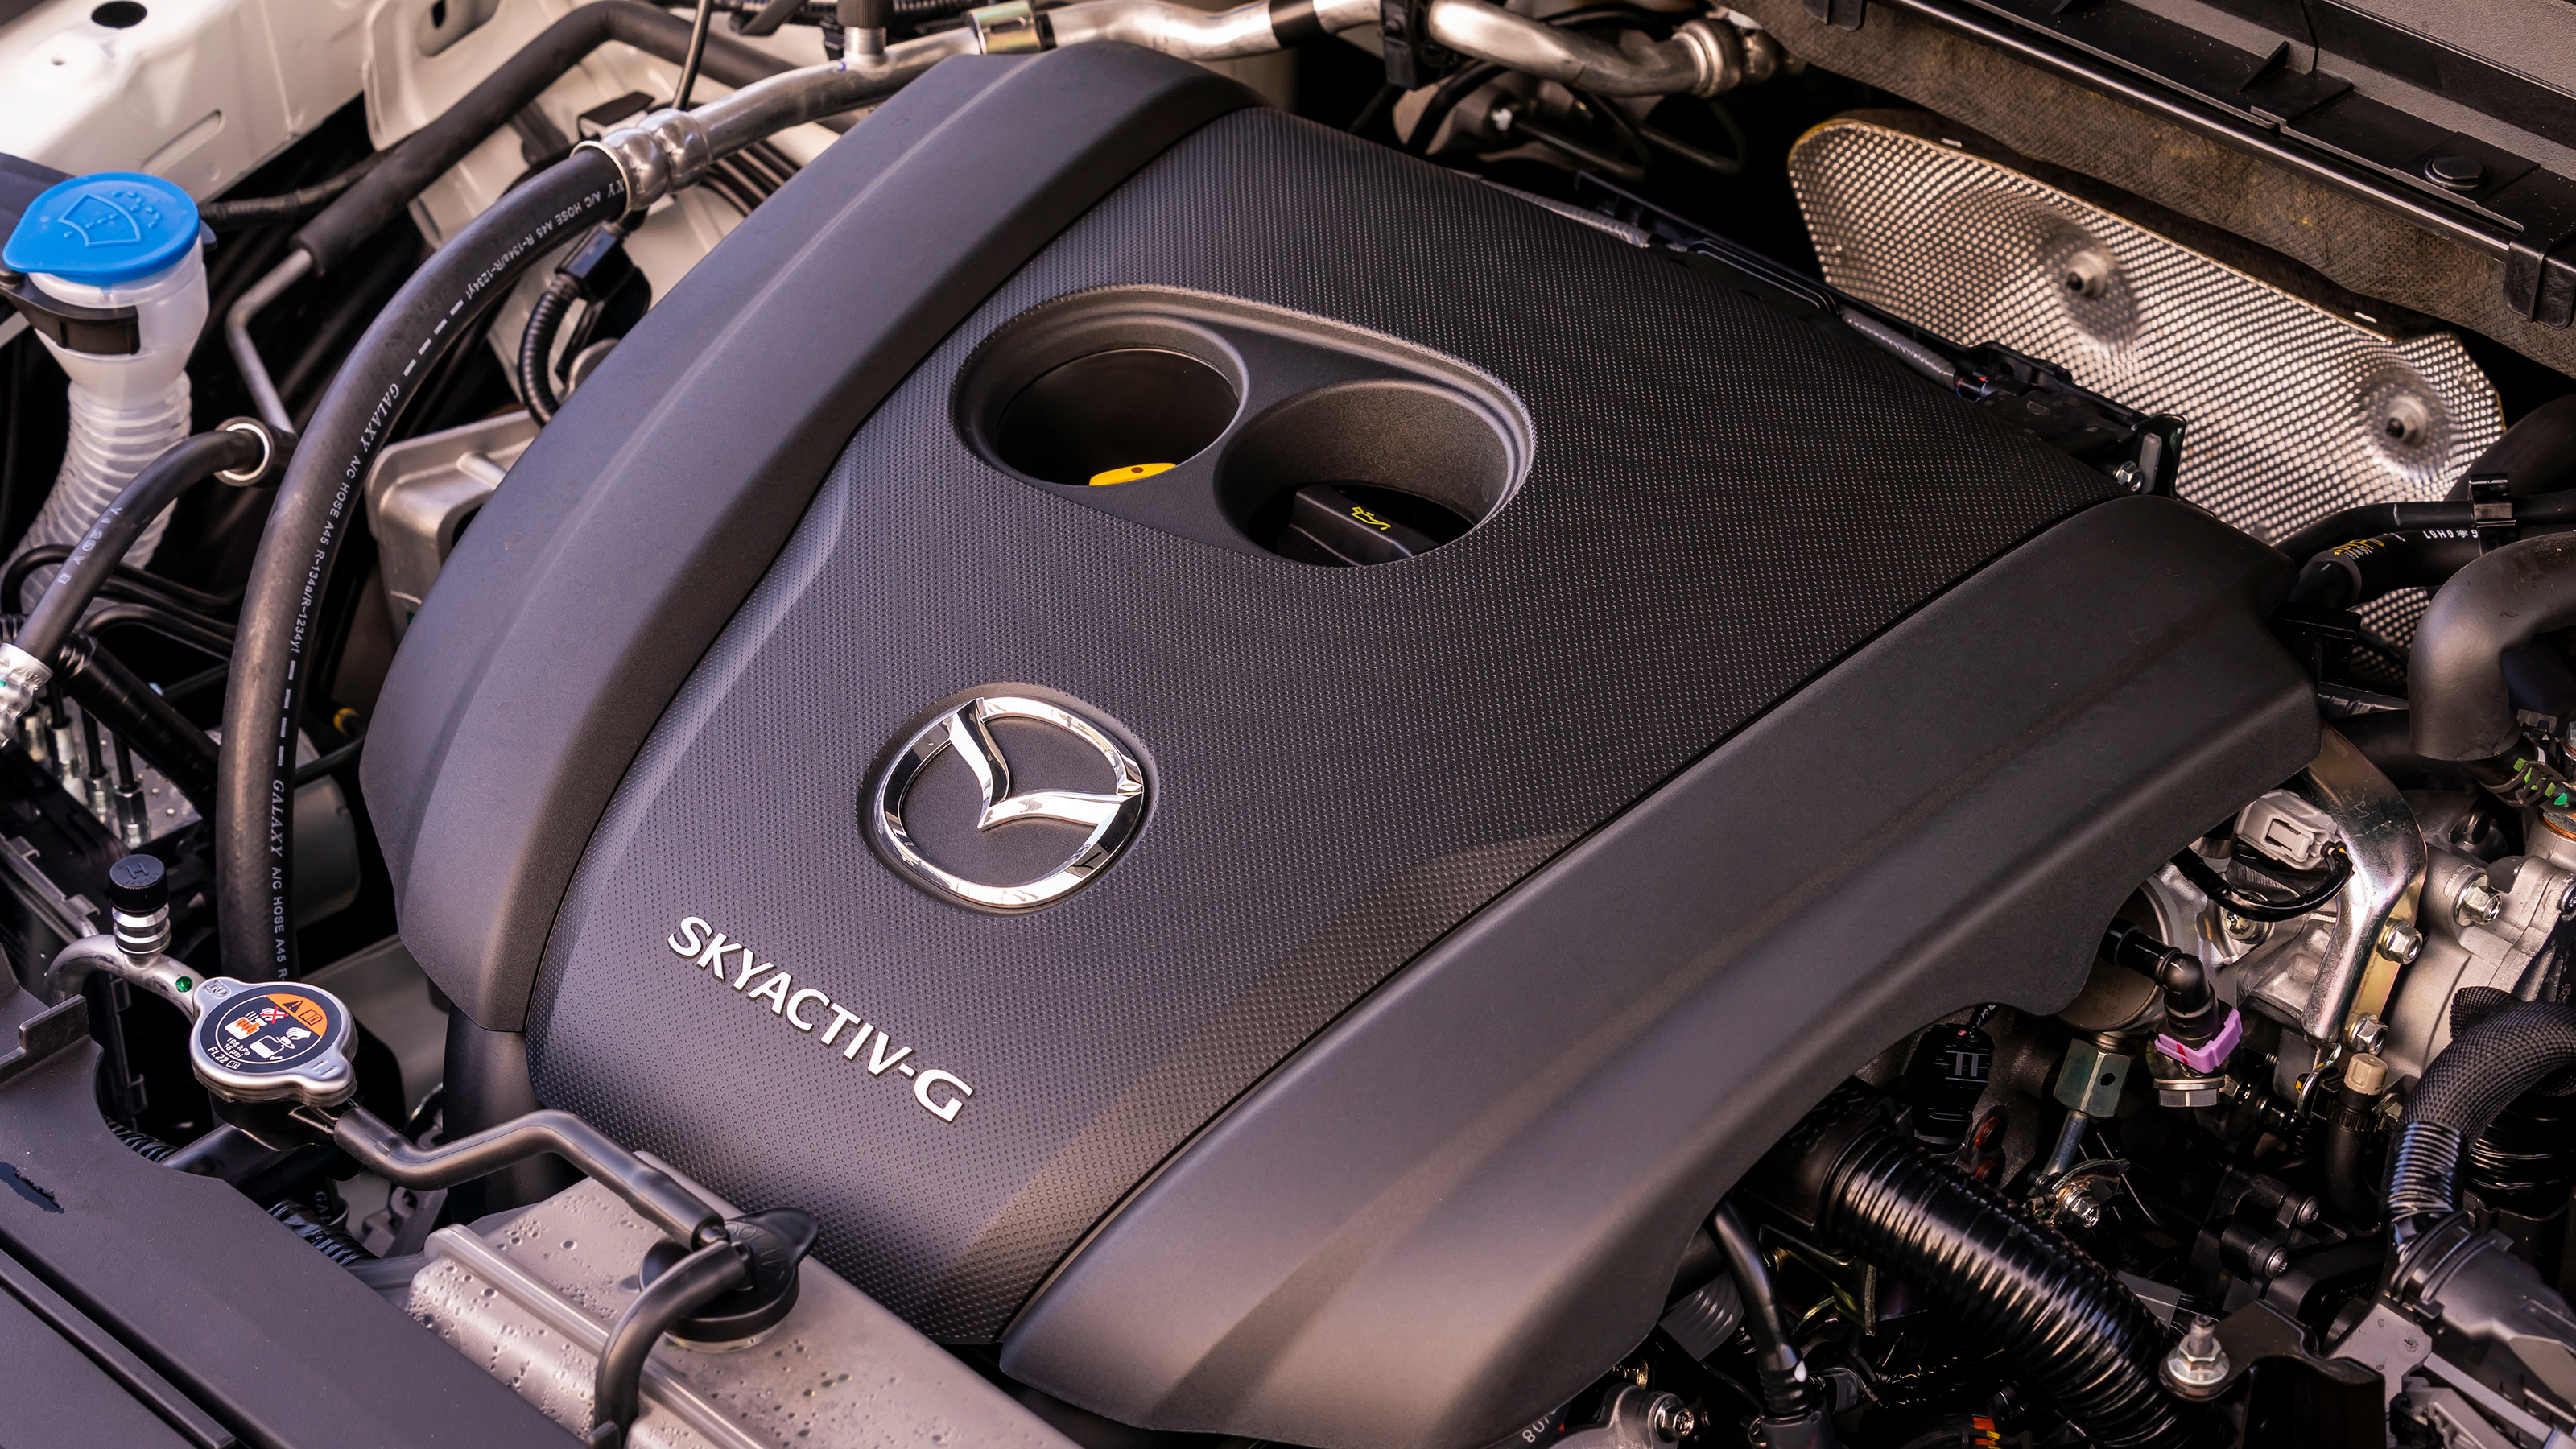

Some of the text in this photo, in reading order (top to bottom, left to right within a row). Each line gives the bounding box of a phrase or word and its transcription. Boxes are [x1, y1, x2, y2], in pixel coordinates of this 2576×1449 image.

[584, 191, 601, 208] A/C
[555, 201, 583, 225] HOSE
[535, 220, 554, 238] A45
[360, 382, 400, 453] GALAXY
[346, 455, 361, 479] A/C
[329, 482, 350, 518] HOSE
[320, 520, 334, 546] A45
[270, 779, 285, 857] GALAXY
[126, 862, 149, 879] H
[272, 866, 282, 890] A/C
[273, 896, 285, 934] HOSE
[275, 939, 287, 963] A45
[667, 916, 975, 1124] SKYACTIV-G
[207, 1046, 229, 1064] FL22
[226, 1037, 251, 1056] 108 kPa
[229, 1049, 244, 1059] psi
